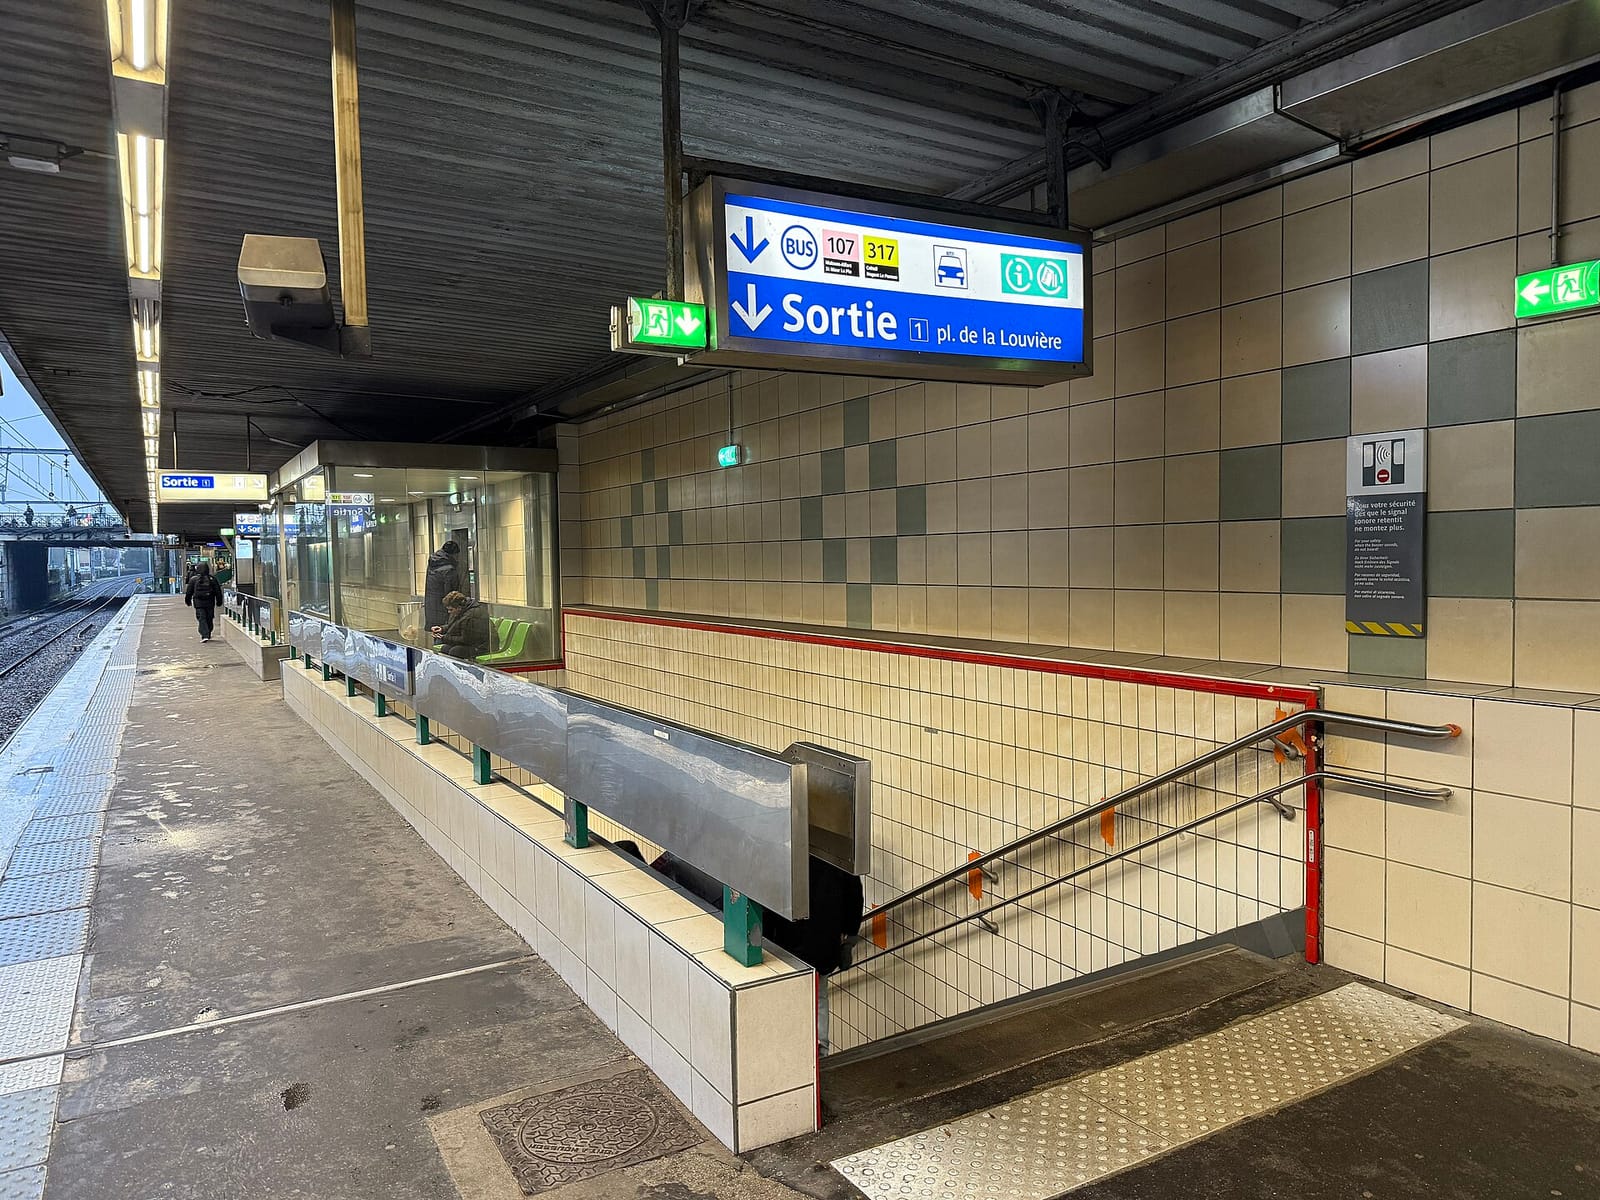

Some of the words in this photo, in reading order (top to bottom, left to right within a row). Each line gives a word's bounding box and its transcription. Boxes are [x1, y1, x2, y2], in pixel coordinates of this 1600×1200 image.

[785, 237, 814, 257] BUS
[827, 236, 855, 256] 107
[867, 241, 895, 261] 317
[782, 293, 898, 342] Sortie
[937, 324, 956, 345] pl.
[959, 325, 979, 345] de
[982, 327, 996, 346] la
[1000, 328, 1062, 350] Louvière
[163, 476, 199, 488] Sortie
[1388, 499, 1416, 508] sécurité
[1366, 510, 1379, 518] que
[1387, 507, 1408, 517] signal
[1377, 515, 1403, 524] retentit
[1388, 523, 1405, 533] plus.
